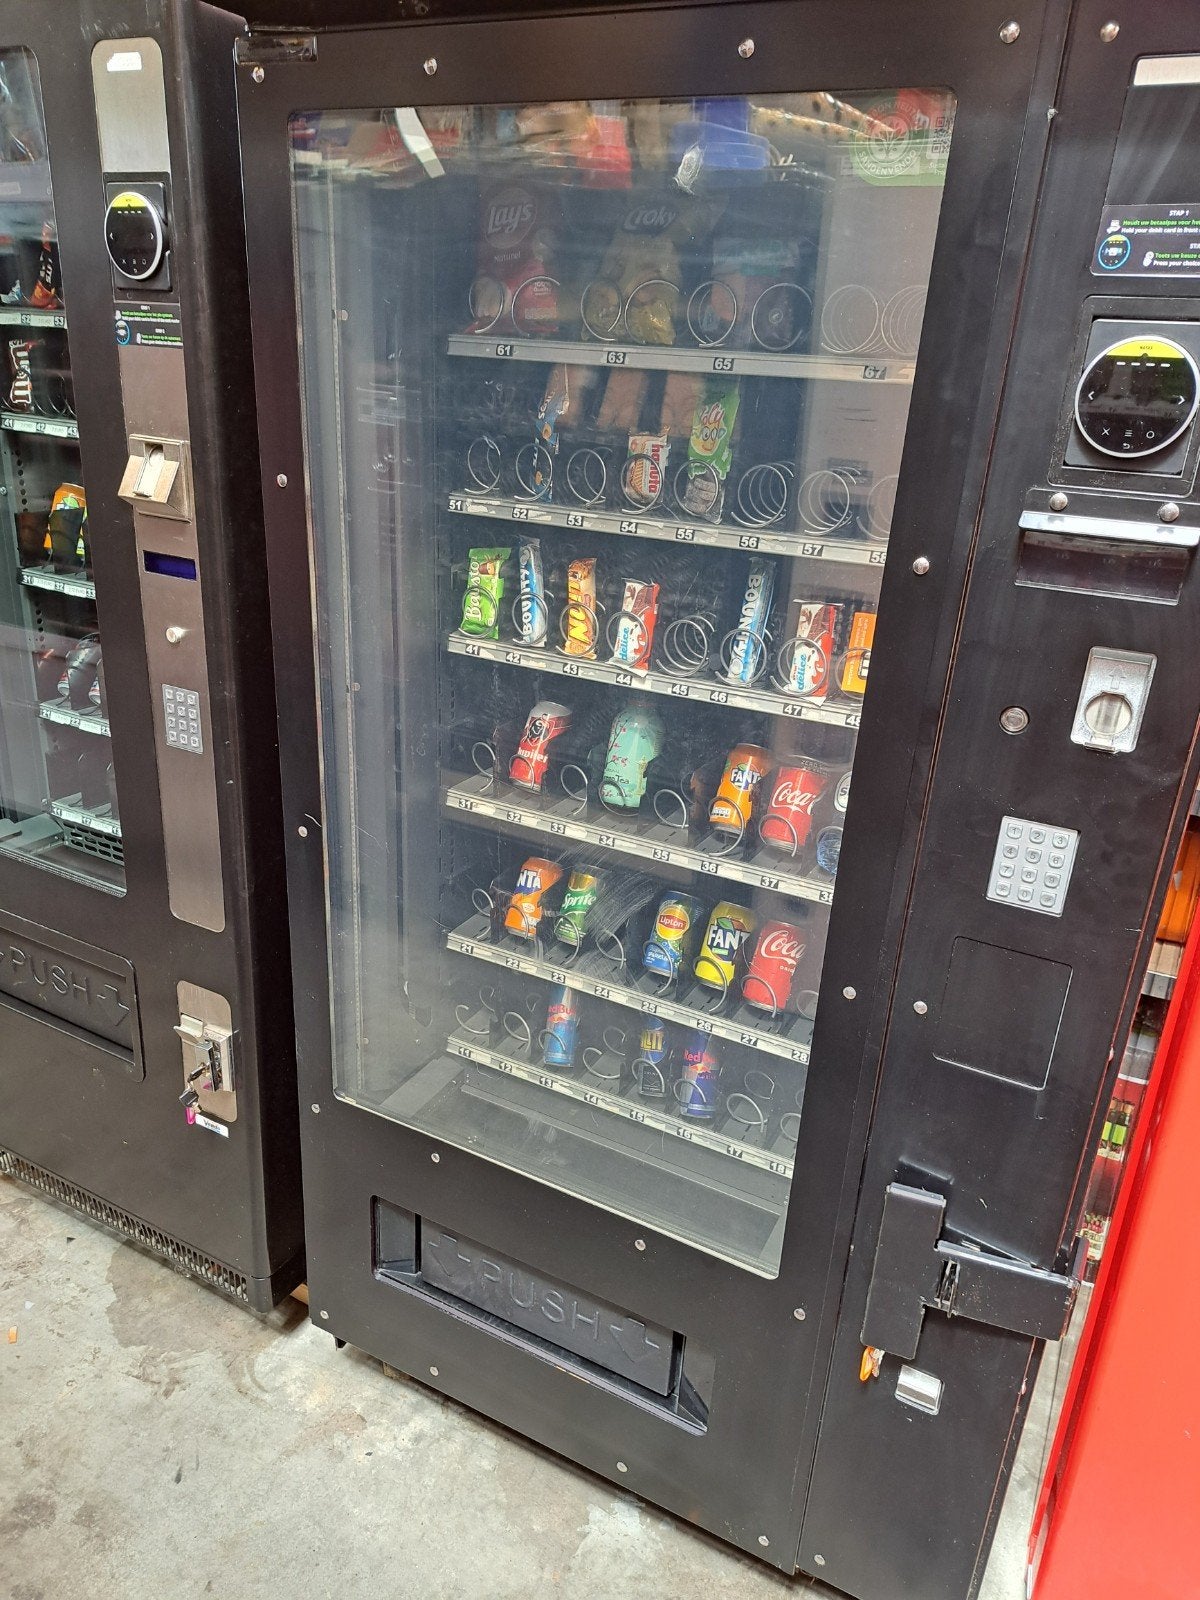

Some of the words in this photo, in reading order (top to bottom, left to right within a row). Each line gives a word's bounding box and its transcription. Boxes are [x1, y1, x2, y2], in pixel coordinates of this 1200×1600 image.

[487, 202, 534, 234] Lay's
[624, 206, 677, 232] Croky
[496, 344, 512, 356] 61
[607, 352, 624, 364] 63
[714, 358, 732, 370] 65
[864, 366, 884, 378] 67
[449, 501, 462, 510] 51
[512, 508, 528, 518] 52
[568, 516, 582, 526] 53
[622, 522, 636, 532] 54
[676, 529, 693, 540] 55
[740, 538, 758, 548] 56
[804, 544, 822, 555] 57
[520, 568, 534, 634] BOUNTY
[733, 574, 762, 658] BOUNTY
[466, 646, 479, 655] 41
[506, 654, 520, 663] 42
[564, 666, 578, 675] 43
[616, 675, 630, 685] 44
[672, 686, 688, 696] 45
[710, 692, 726, 702] 46
[784, 705, 801, 716] 47
[731, 768, 761, 784] FANT
[460, 800, 471, 810] 31
[508, 812, 520, 821] 32
[552, 823, 565, 832] 33
[600, 836, 614, 846] 34
[654, 850, 669, 860] 35
[702, 862, 717, 872] 36
[762, 878, 778, 888] 37
[562, 892, 597, 910] Sprite
[660, 916, 684, 928] Lipton
[9, 945, 90, 1004] PUSH
[462, 944, 473, 953] 21
[506, 960, 520, 968] 22
[552, 974, 565, 982] 23
[596, 988, 609, 998] 24
[642, 1002, 656, 1012] 25
[698, 1020, 712, 1030] 26
[742, 1035, 758, 1045] 27
[792, 1052, 808, 1062] 28
[460, 1048, 471, 1058] 11
[501, 1064, 512, 1073] 12
[540, 1078, 553, 1088] 13
[585, 1094, 598, 1104] 14
[631, 1112, 644, 1121] 15
[678, 1130, 691, 1139] 16
[728, 1146, 742, 1156] 17
[771, 1163, 786, 1174] 18
[480, 1258, 600, 1341] PUSH
